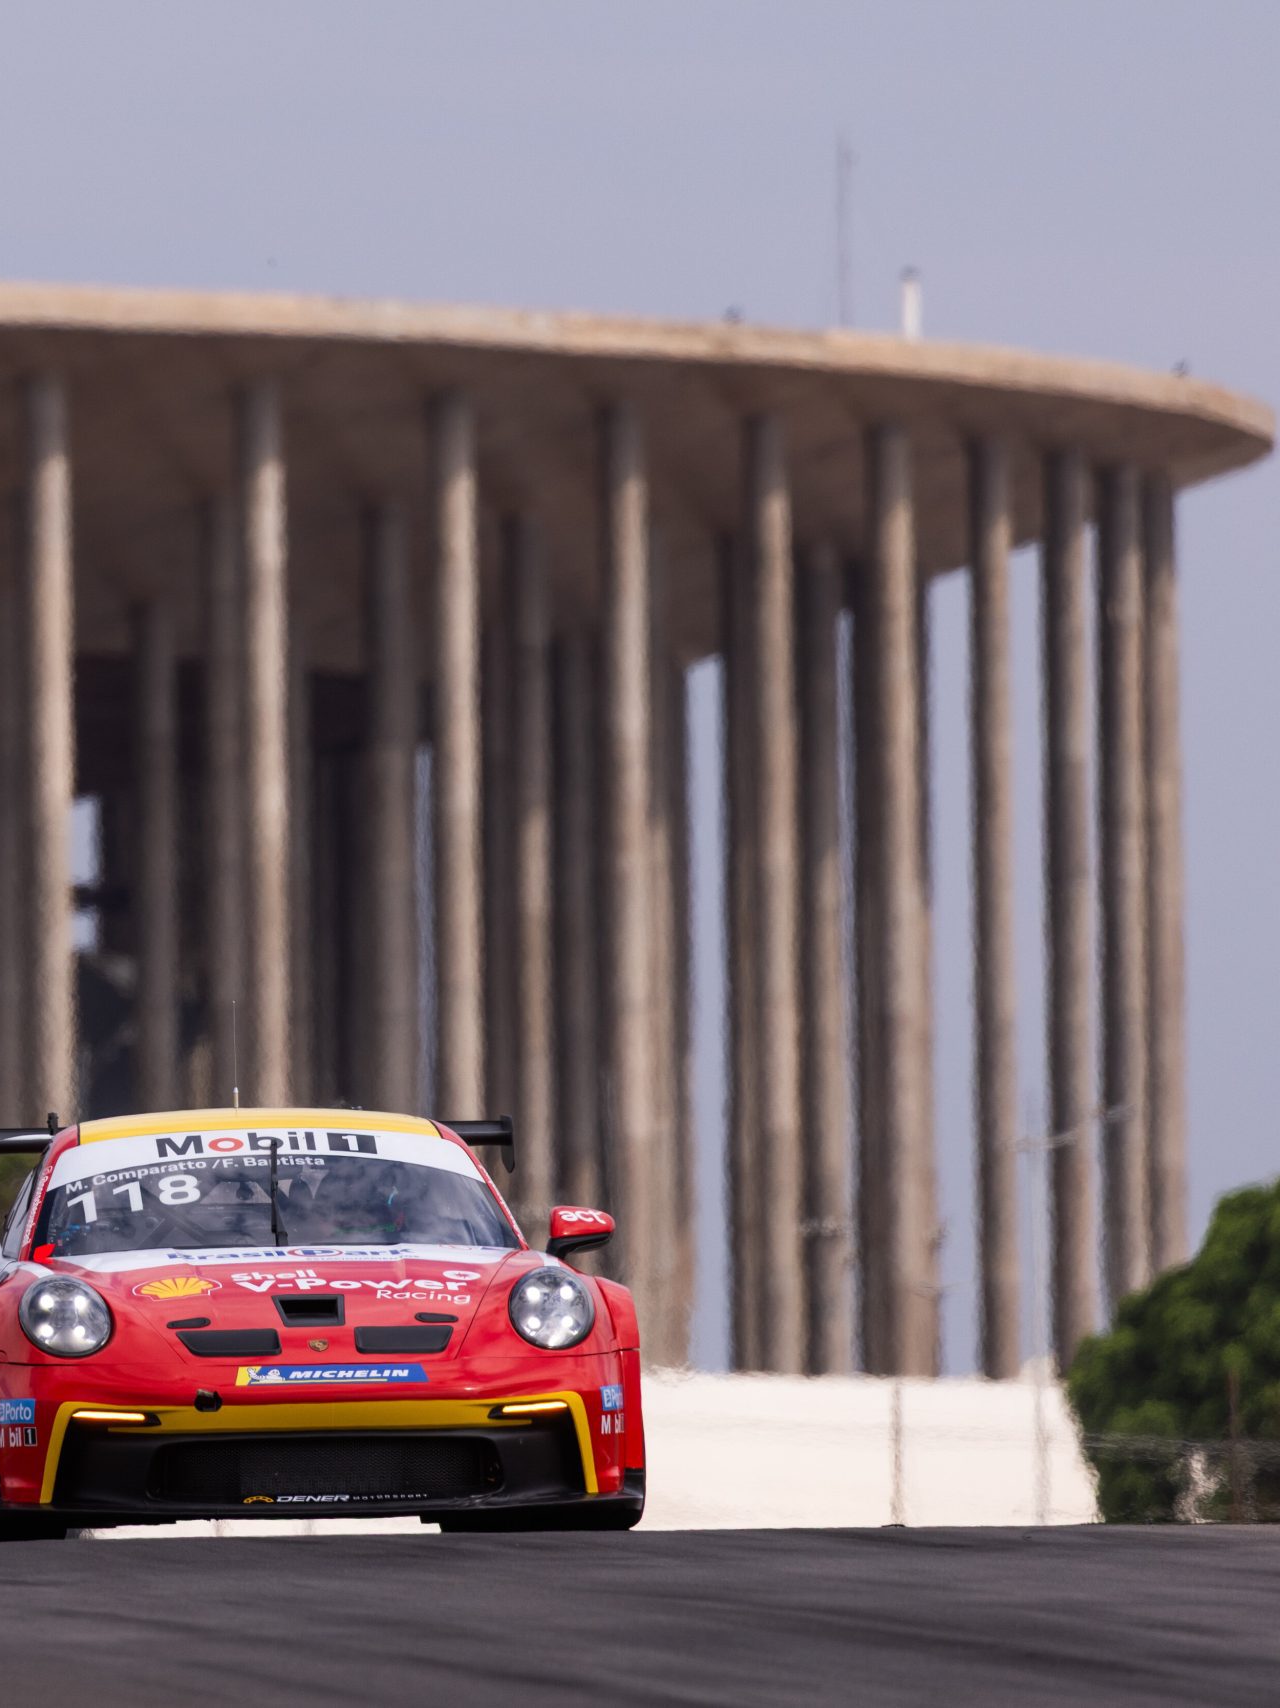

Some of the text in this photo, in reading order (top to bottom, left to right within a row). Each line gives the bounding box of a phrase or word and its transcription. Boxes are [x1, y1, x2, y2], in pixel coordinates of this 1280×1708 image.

[155, 1132, 317, 1158] Mobil
[65, 1180, 89, 1195] M.
[91, 1160, 208, 1187] Comparatto
[66, 1173, 201, 1224] 118
[230, 1269, 318, 1282] Shell
[235, 1278, 468, 1293] V-Power
[376, 1289, 472, 1305] Racing
[289, 1369, 410, 1379] MICHELIN
[5, 1402, 32, 1421] Porto
[276, 1494, 350, 1503] DENER
